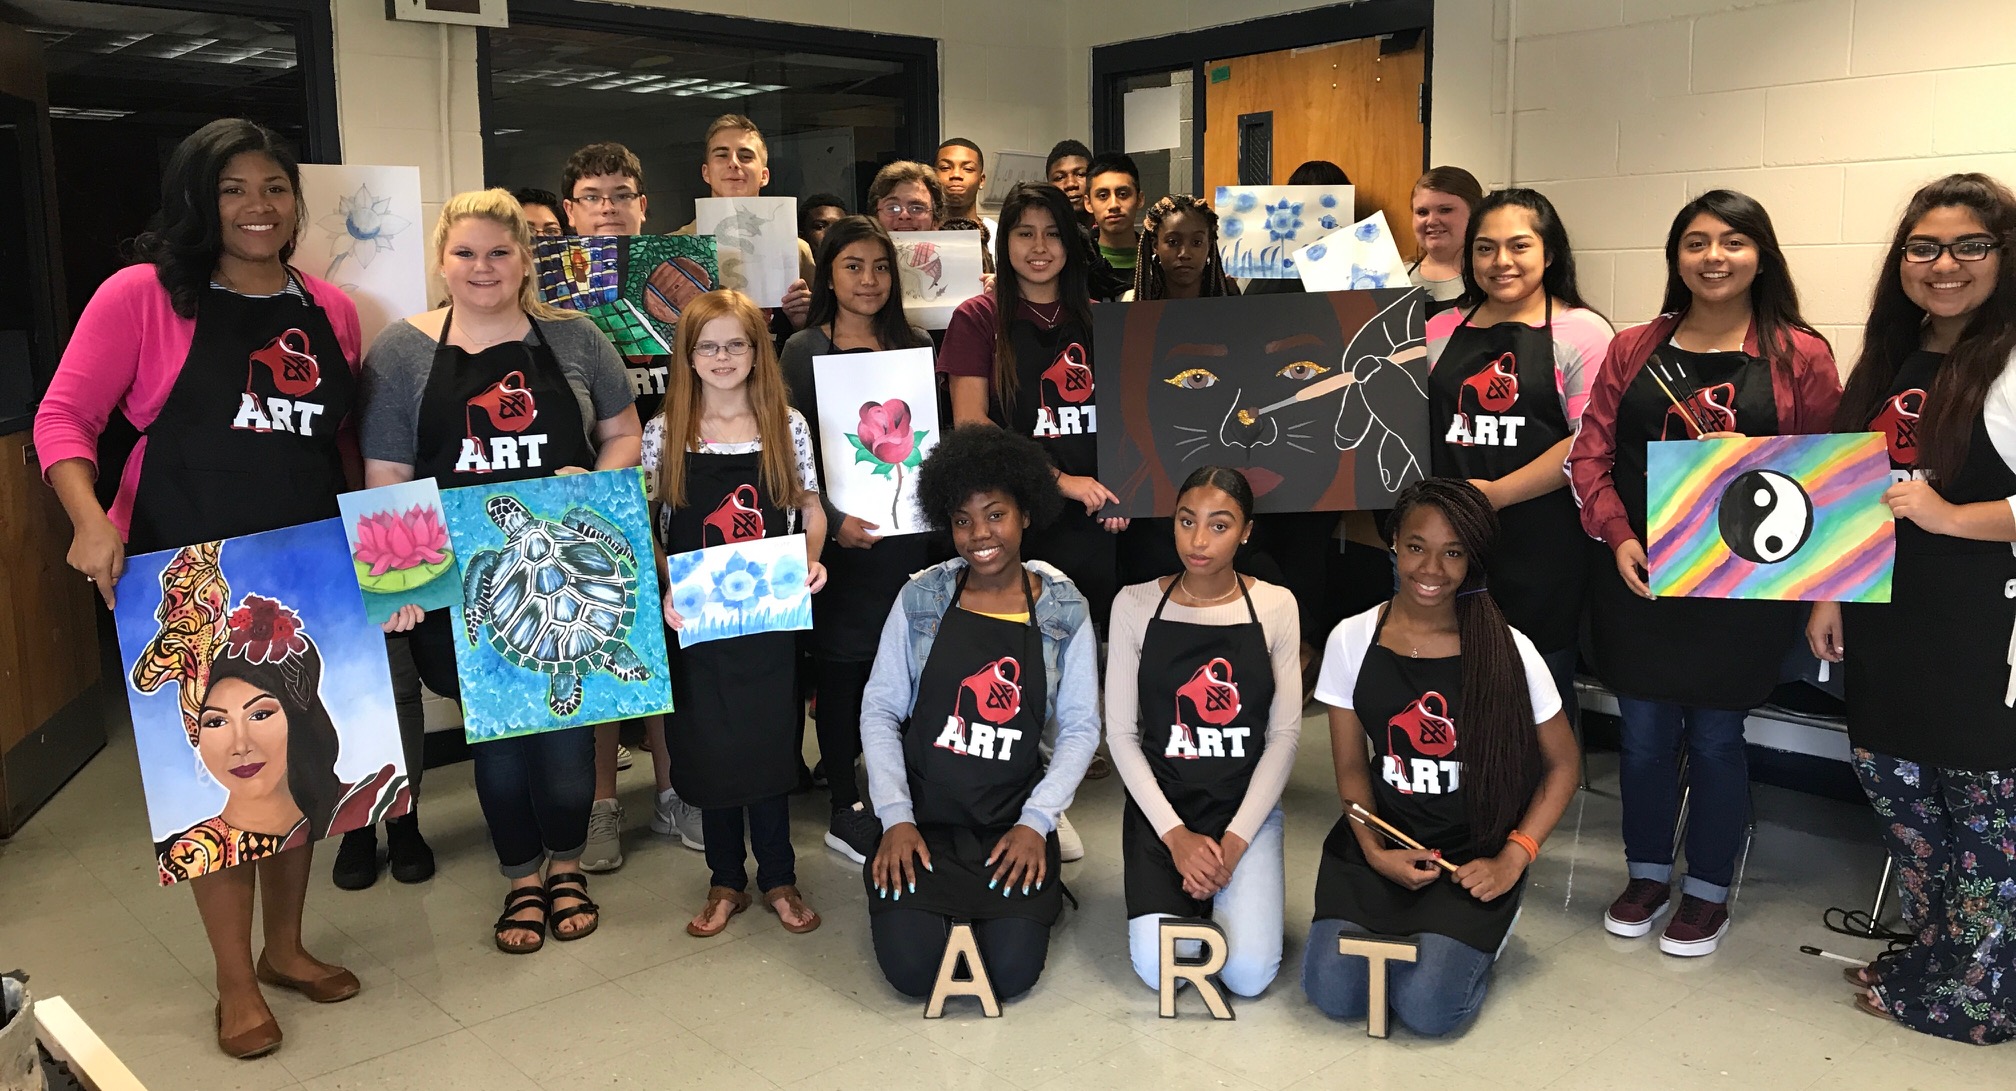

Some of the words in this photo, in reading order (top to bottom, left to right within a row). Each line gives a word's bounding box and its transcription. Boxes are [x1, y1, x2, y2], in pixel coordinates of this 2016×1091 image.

[626, 366, 669, 395] RT
[231, 392, 325, 437] ART
[1444, 413, 1526, 447] ART
[454, 433, 548, 474] ART
[933, 714, 1023, 761] ART
[1164, 723, 1251, 759] ART
[1382, 754, 1461, 795] ART
